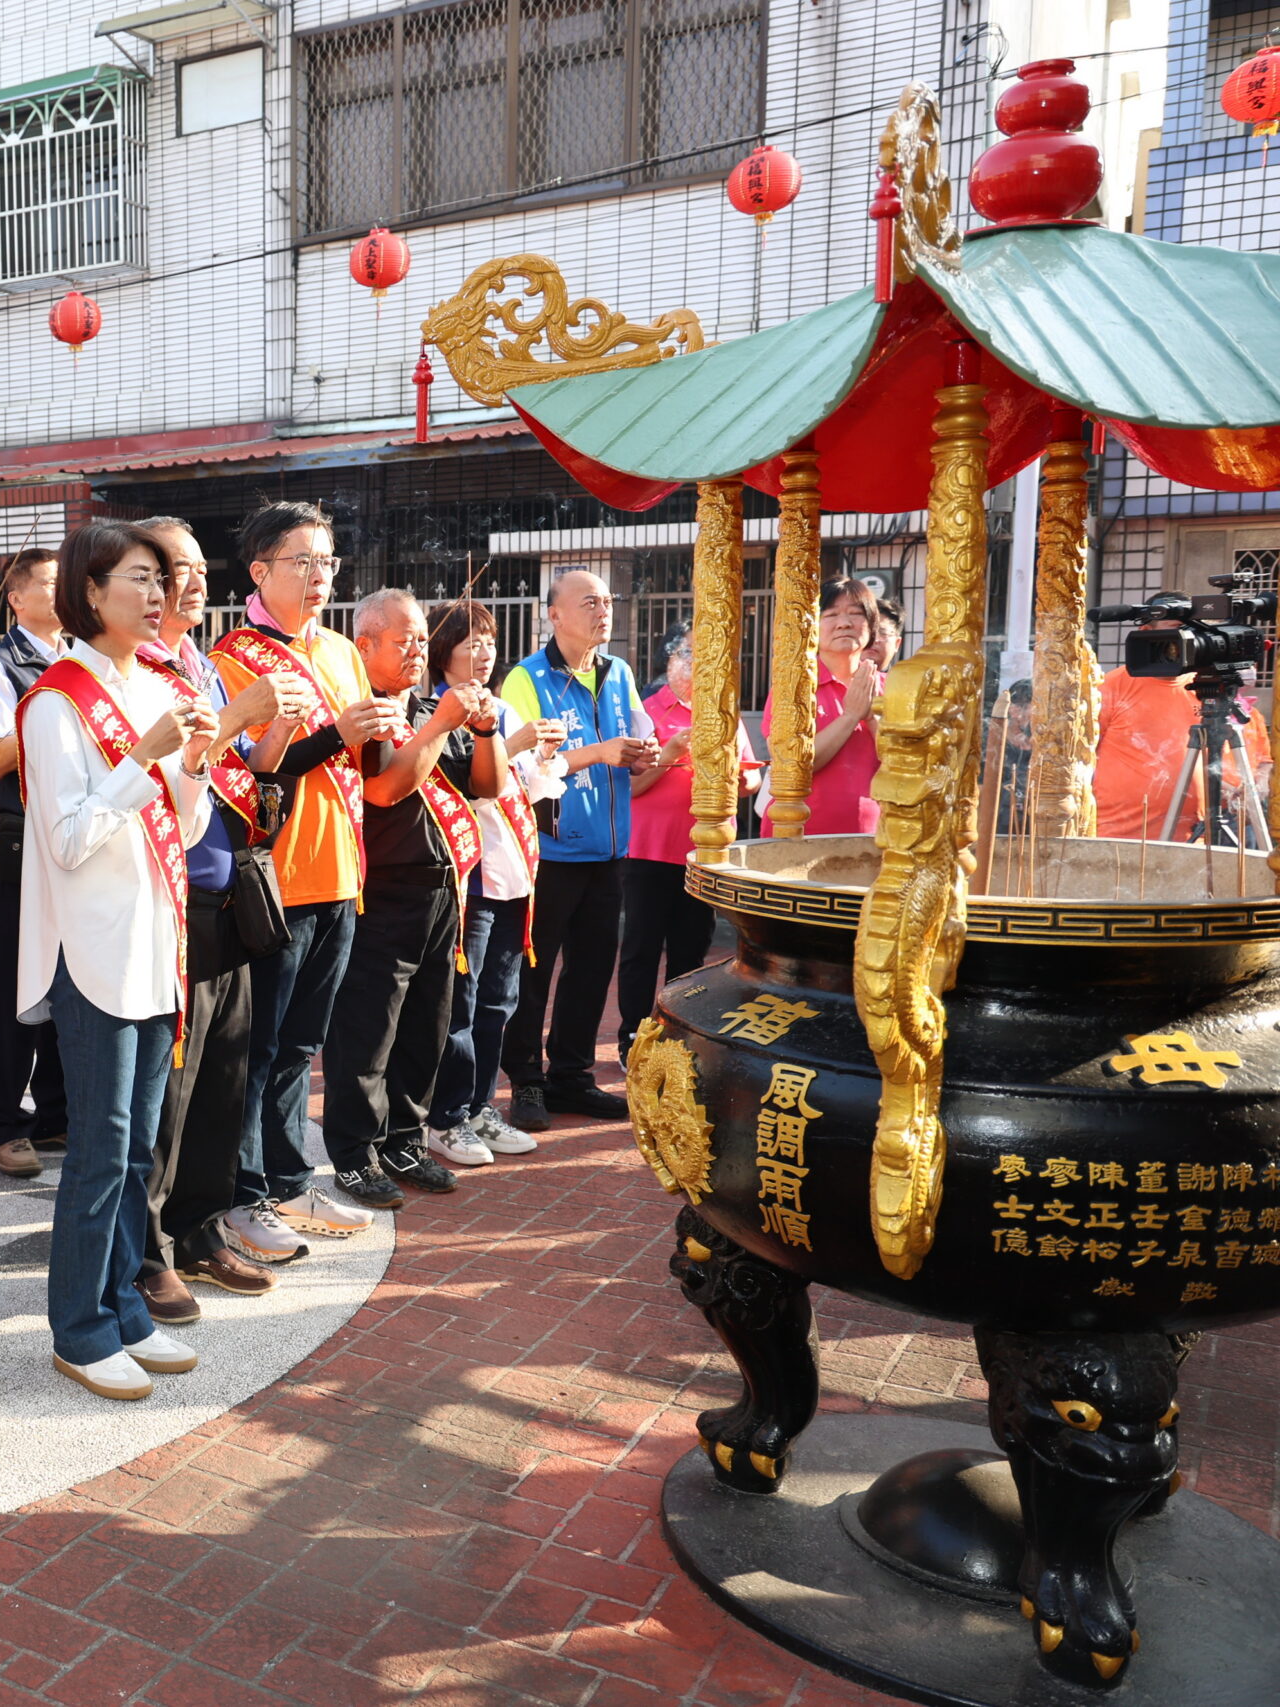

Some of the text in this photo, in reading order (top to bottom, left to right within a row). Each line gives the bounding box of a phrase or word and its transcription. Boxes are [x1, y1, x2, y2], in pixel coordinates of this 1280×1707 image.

[90, 698, 133, 755] 福興宮
[717, 993, 822, 1046] 福
[1110, 1030, 1243, 1089] 母
[756, 1062, 824, 1252] 風調雨順
[991, 1153, 1034, 1257] 廖士億
[1081, 1160, 1129, 1263] 陳正松
